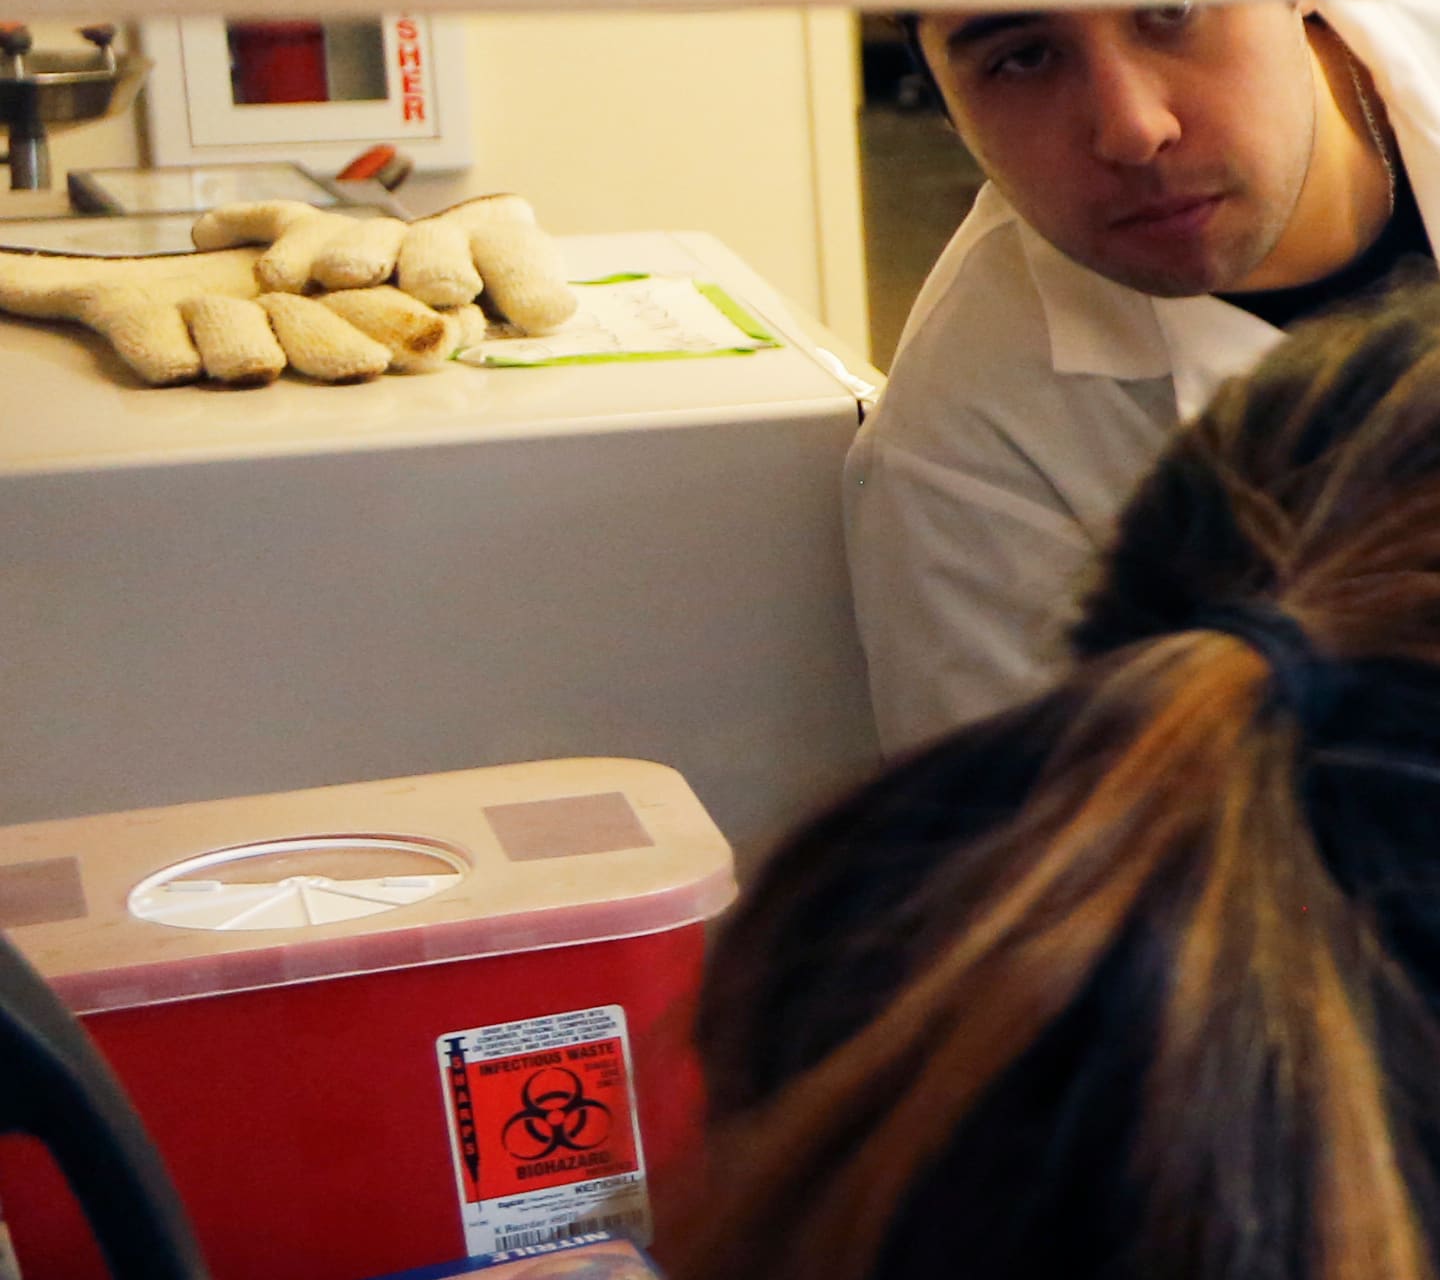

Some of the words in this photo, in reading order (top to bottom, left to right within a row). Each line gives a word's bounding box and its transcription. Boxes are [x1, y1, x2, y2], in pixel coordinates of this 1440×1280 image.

[479, 1053, 561, 1076] INFECTIOUS
[567, 1042, 614, 1061] WASTE
[515, 1151, 612, 1180] BIOHAZARD
[491, 1230, 611, 1263] NITRILE
